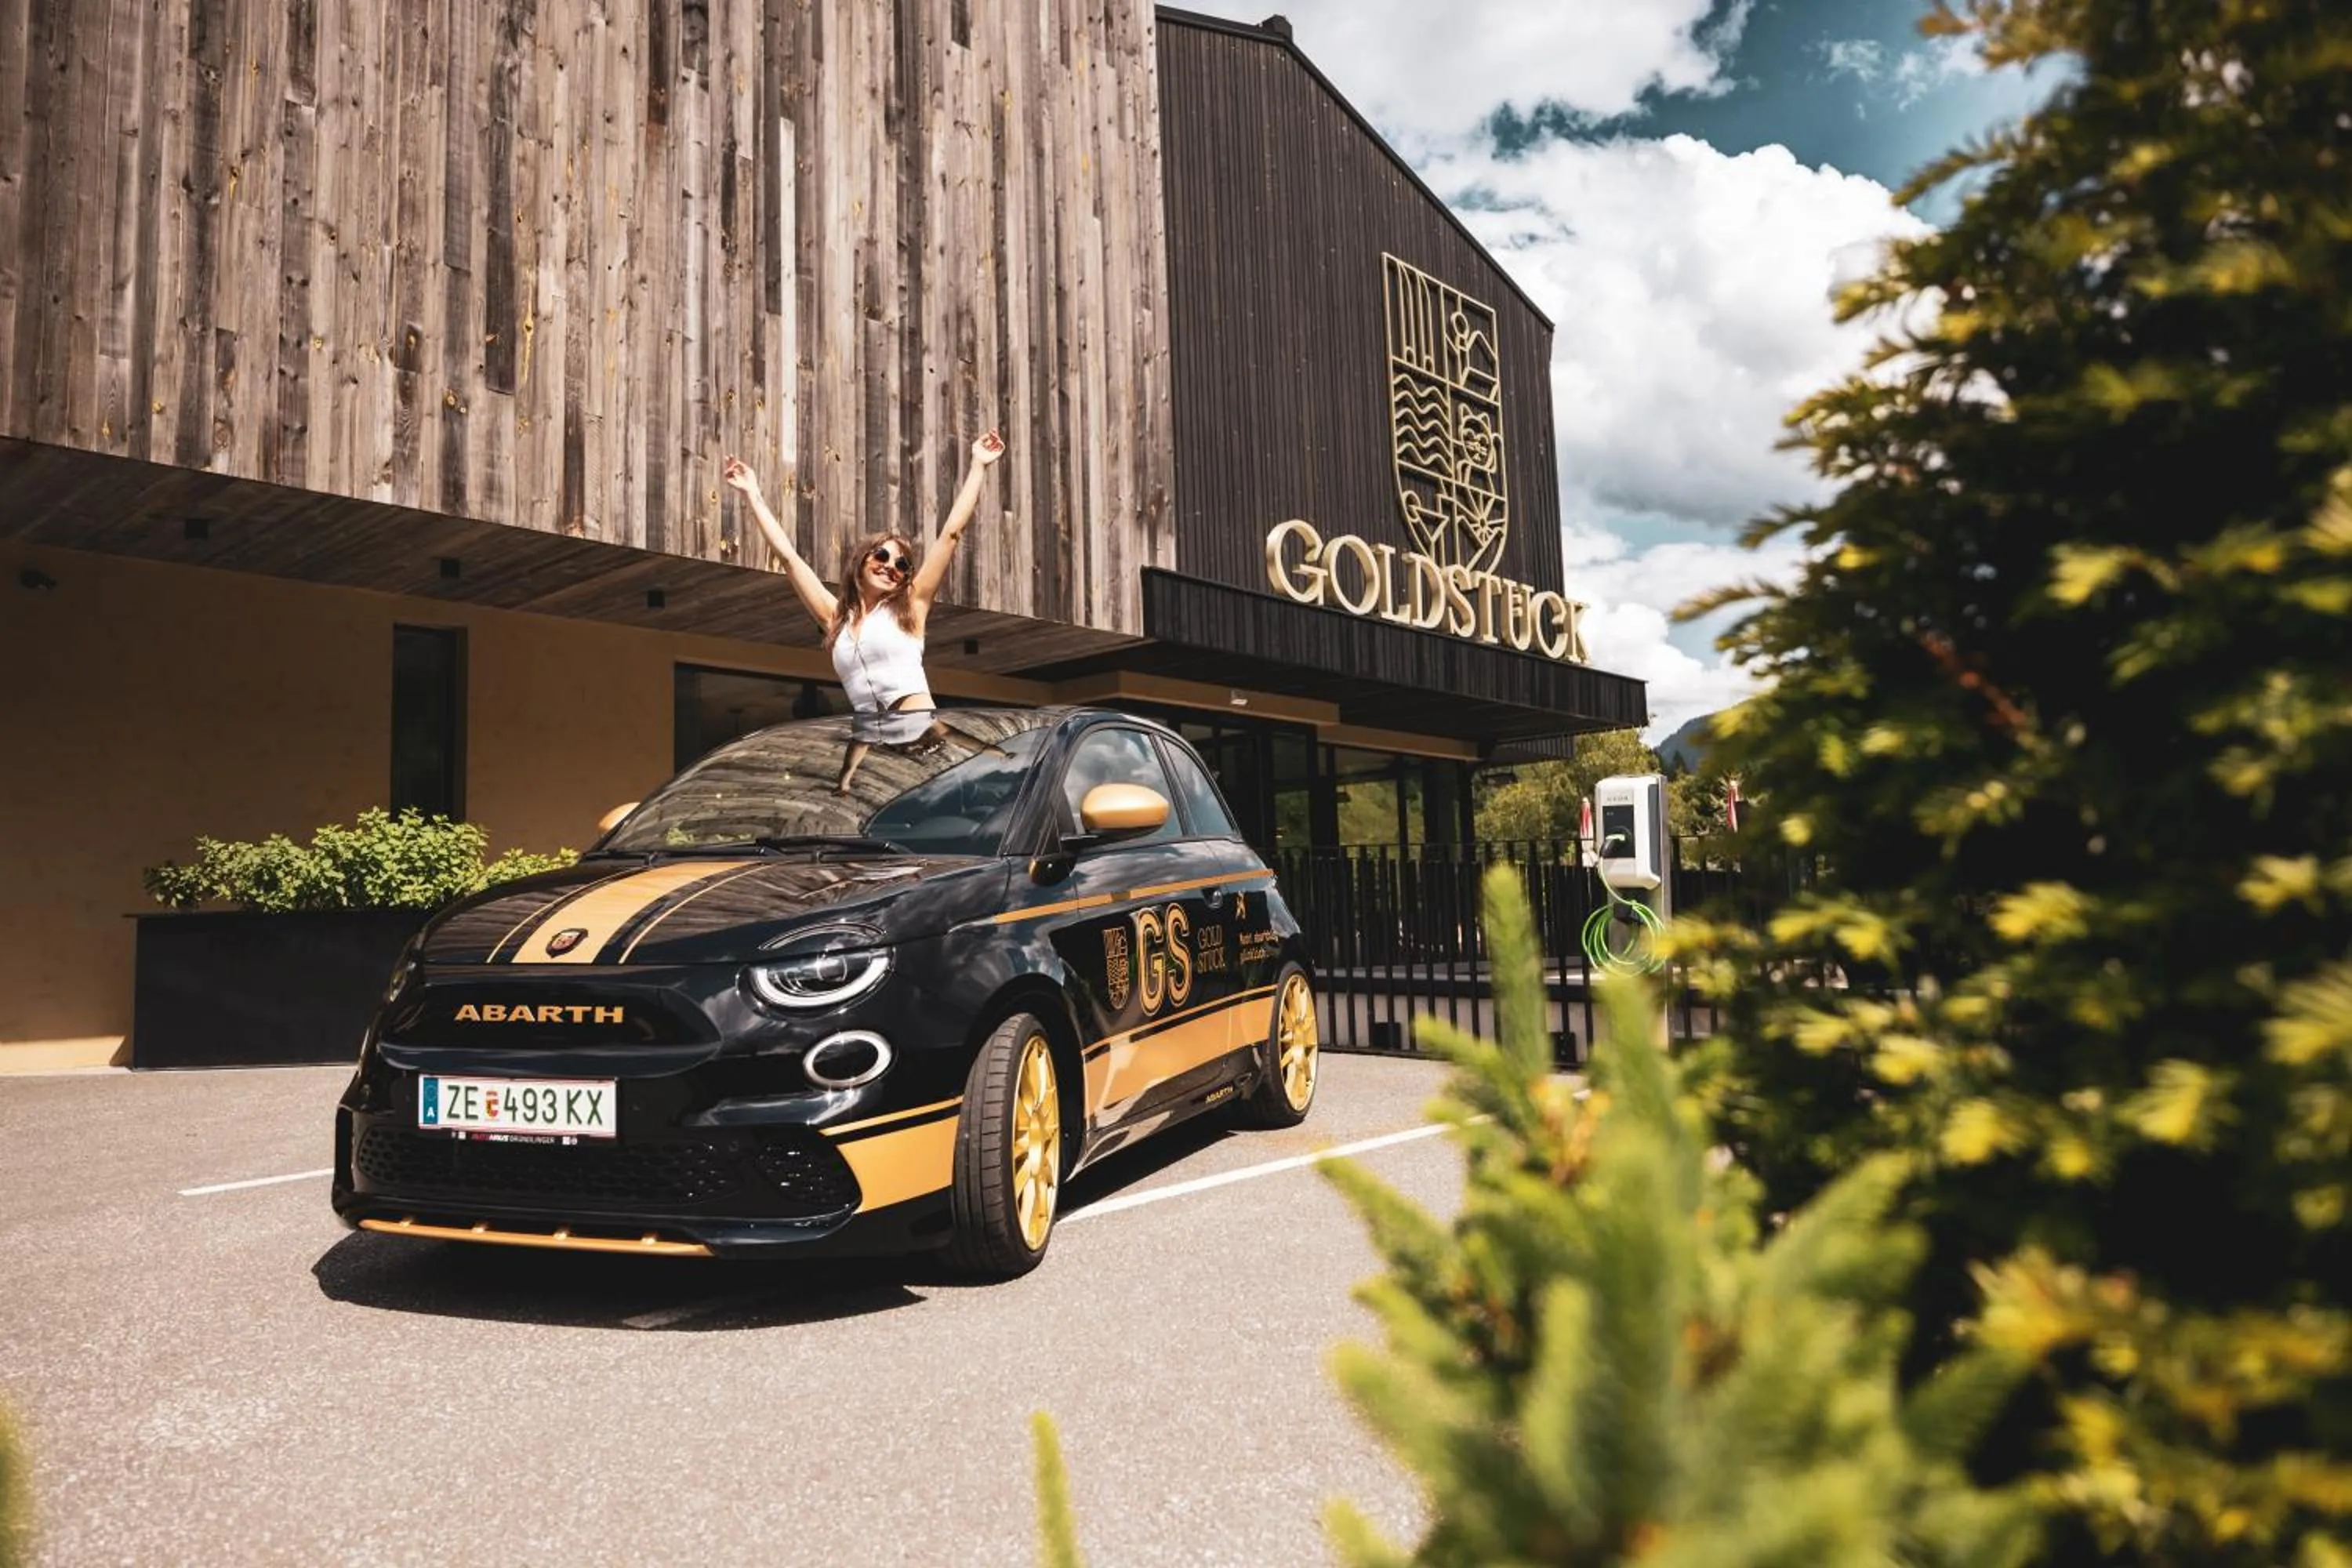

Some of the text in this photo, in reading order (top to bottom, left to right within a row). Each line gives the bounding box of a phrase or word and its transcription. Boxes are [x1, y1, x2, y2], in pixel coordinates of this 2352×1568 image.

[1138, 902, 1192, 1017] GS
[454, 1004, 625, 1024] ABARTH
[426, 1105, 435, 1119] A
[445, 1084, 603, 1126] ZE 493 KX
